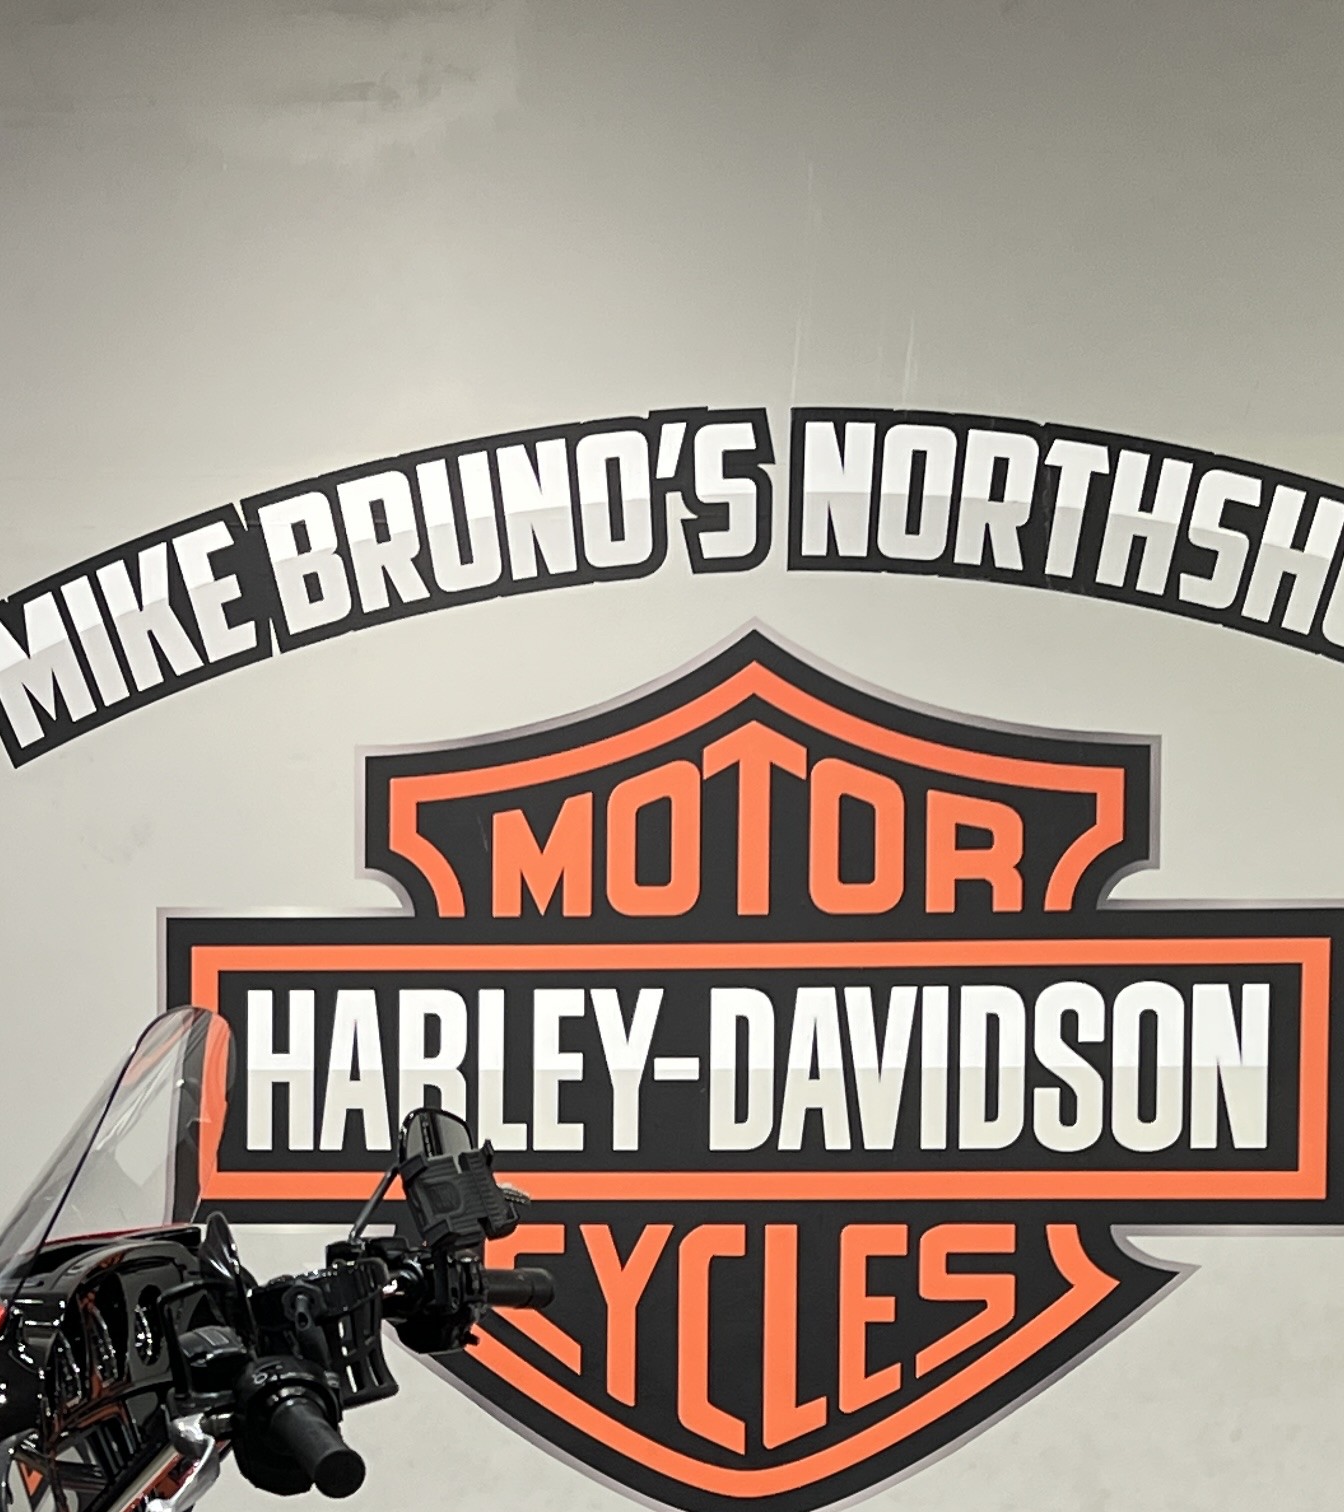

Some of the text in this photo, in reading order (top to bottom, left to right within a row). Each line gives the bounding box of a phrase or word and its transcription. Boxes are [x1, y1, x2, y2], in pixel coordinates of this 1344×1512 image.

[257, 422, 756, 636] BRUNO'S
[492, 720, 1024, 918] MOTOR
[246, 980, 1270, 1153] HARLEY-DAVIDSON
[484, 1223, 1017, 1458] CYCLES
